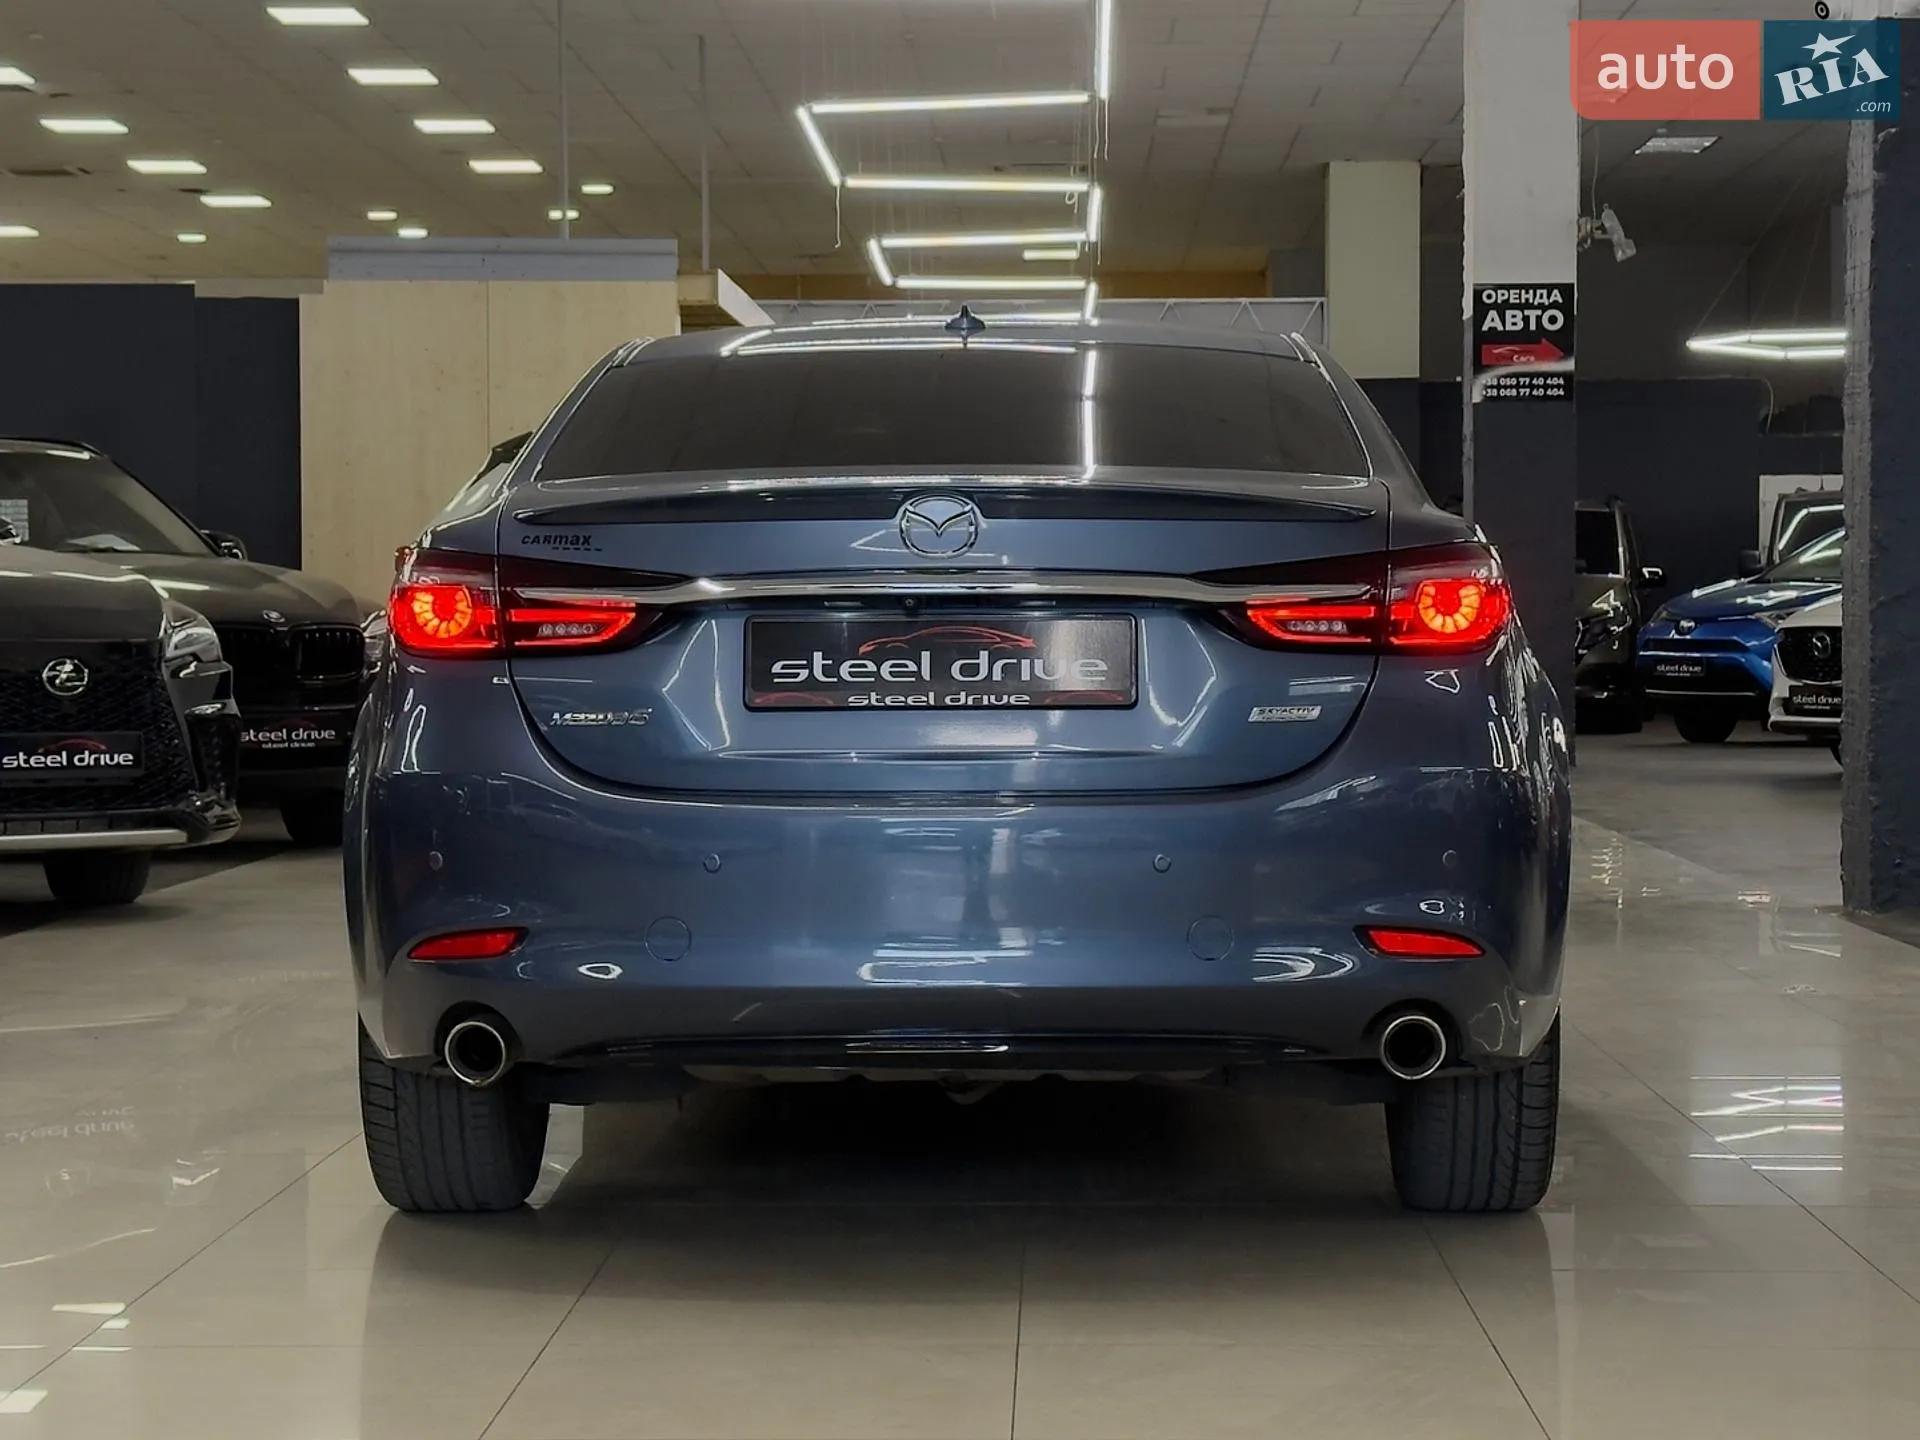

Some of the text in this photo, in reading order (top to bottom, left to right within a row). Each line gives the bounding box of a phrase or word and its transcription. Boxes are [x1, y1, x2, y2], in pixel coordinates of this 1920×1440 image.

[1481, 289, 1563, 306] ОРЕНДА
[1481, 309, 1564, 332] АВТО
[1546, 377, 1564, 385] 404
[1519, 388, 1530, 396] 77
[1532, 388, 1545, 396] 40
[1546, 388, 1565, 396] 404
[770, 650, 1109, 683] steel drive
[847, 691, 1031, 706] steel drive
[240, 728, 336, 742] steel drive
[2, 750, 135, 768] steel drive
